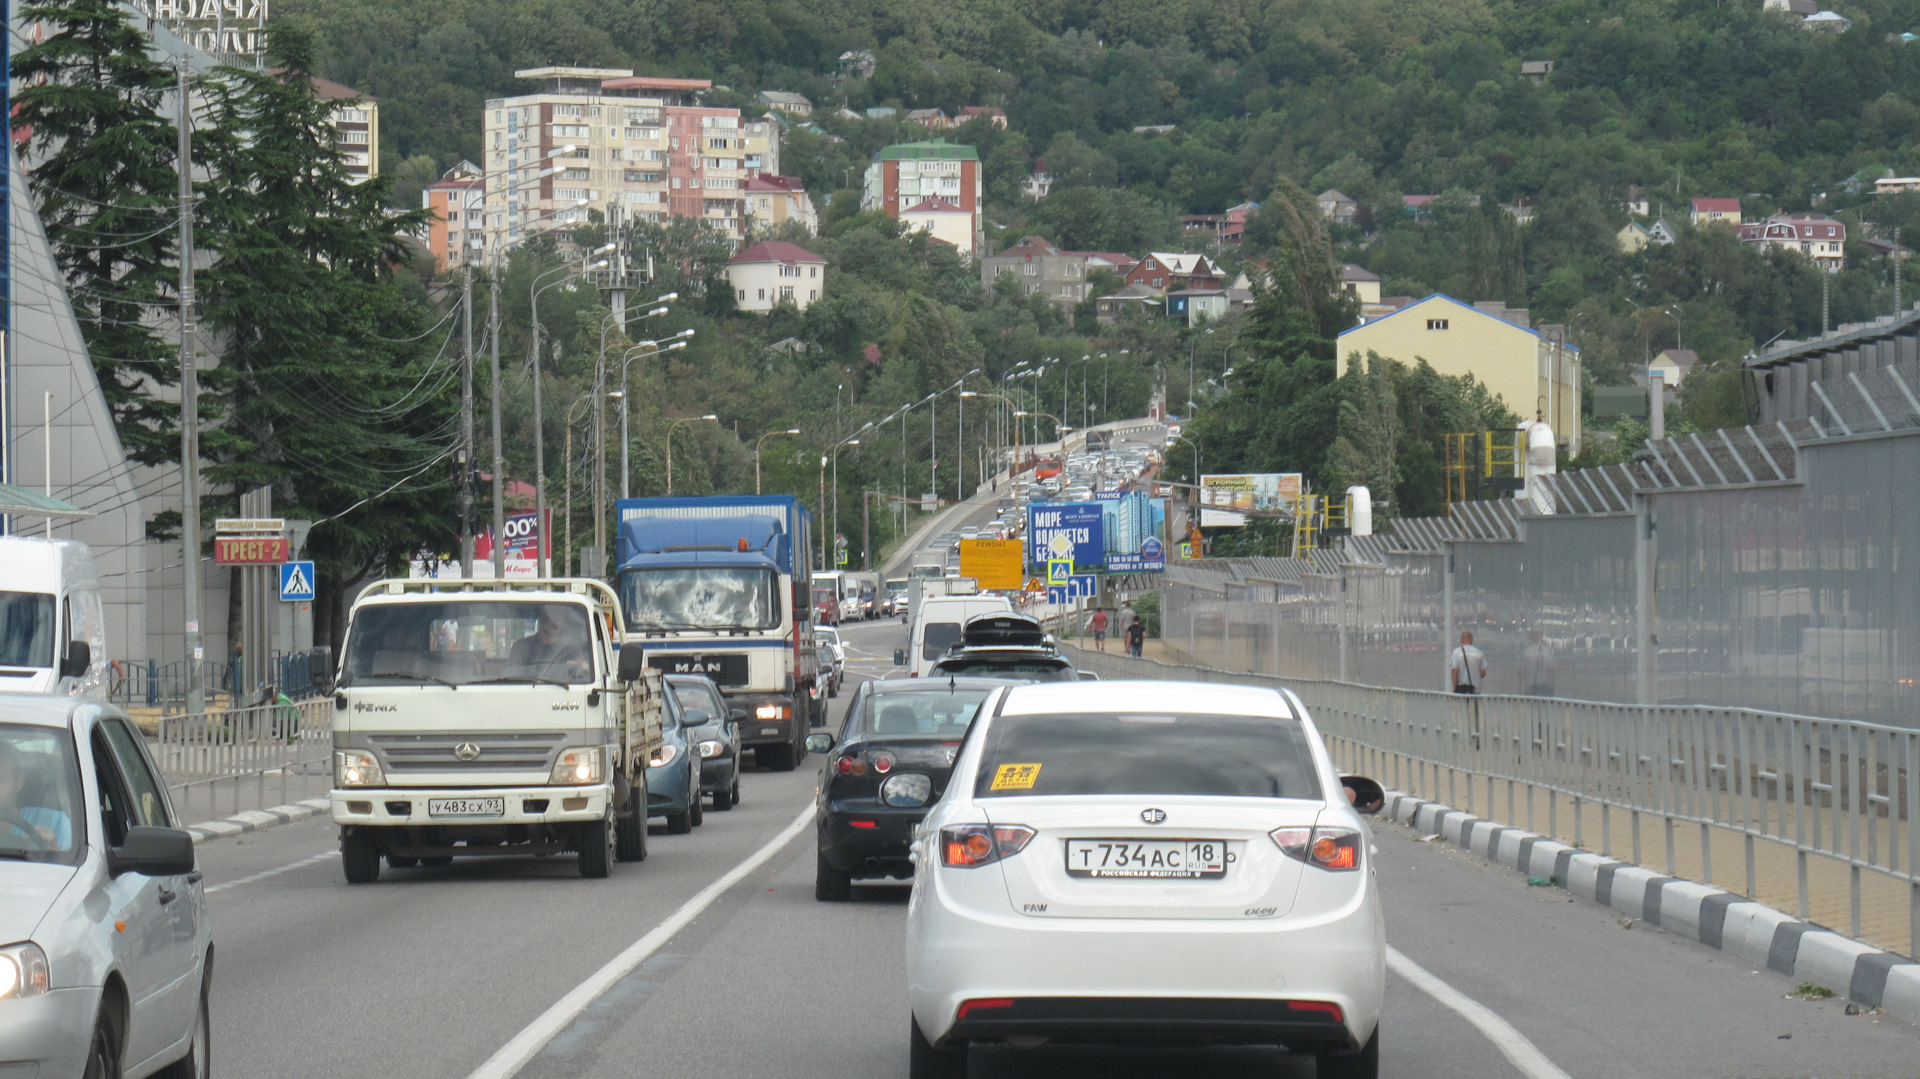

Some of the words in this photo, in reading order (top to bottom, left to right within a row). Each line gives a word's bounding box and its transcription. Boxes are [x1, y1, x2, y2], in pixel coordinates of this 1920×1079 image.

[1097, 492, 1121, 500] ТУАПСЕ
[1035, 511, 1062, 528] МОРЕ
[221, 541, 281, 561] ТРЕСТ-2
[675, 663, 721, 673] MAN
[551, 701, 580, 711] BAW
[1188, 862, 1207, 870] RUS
[1150, 870, 1192, 878] ФЕДЕРАЦИЯ
[1023, 903, 1049, 913] FAW
